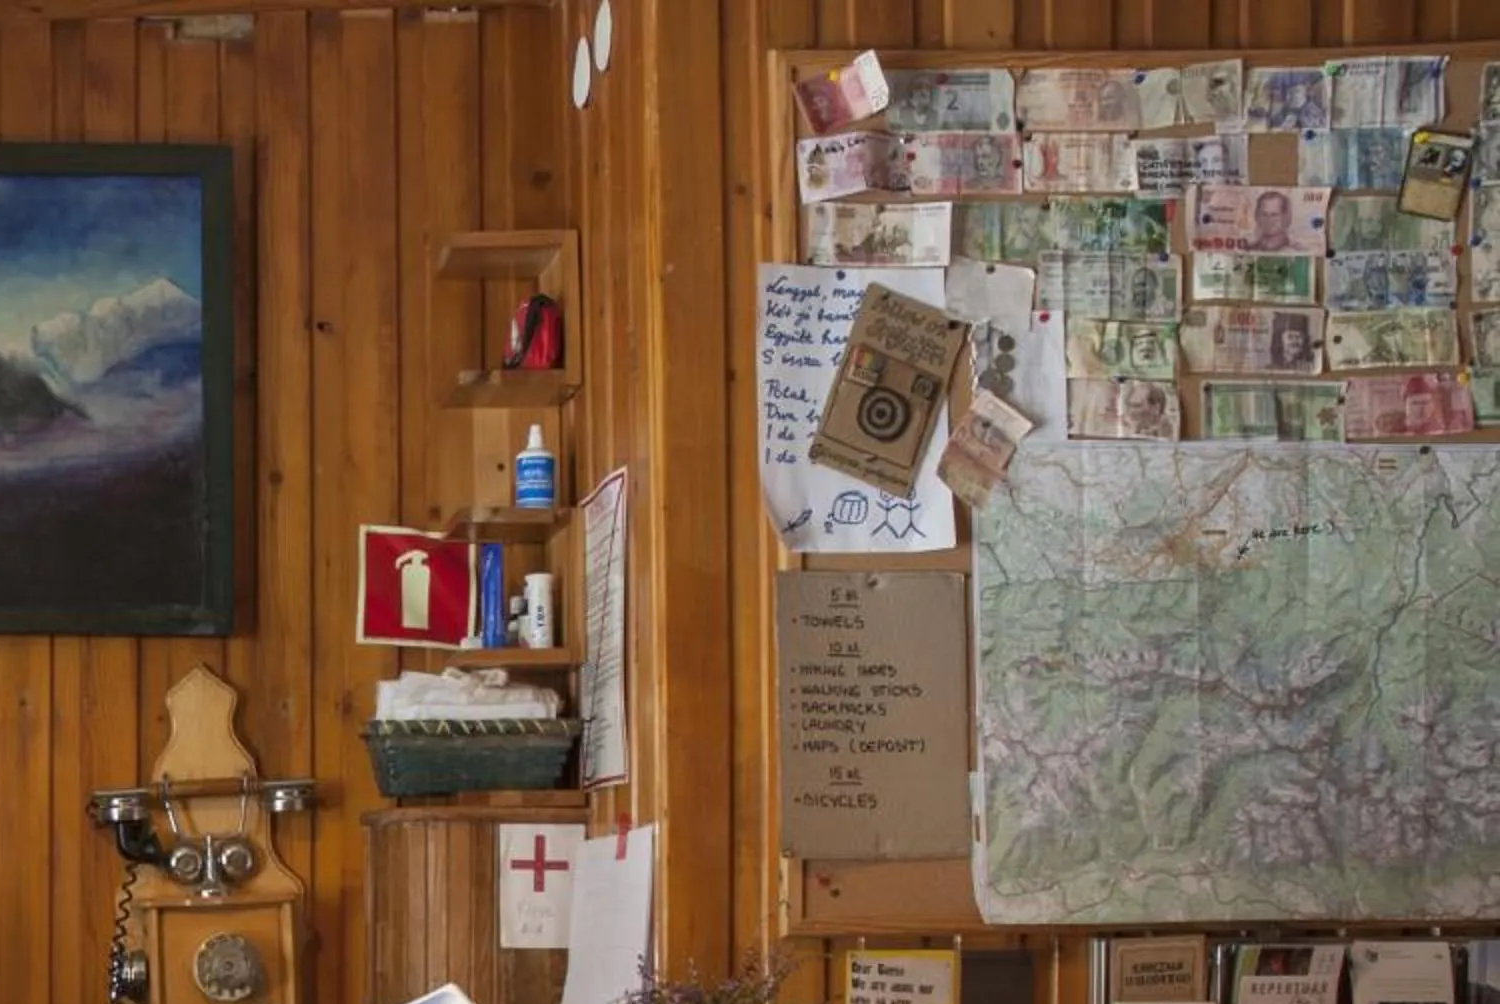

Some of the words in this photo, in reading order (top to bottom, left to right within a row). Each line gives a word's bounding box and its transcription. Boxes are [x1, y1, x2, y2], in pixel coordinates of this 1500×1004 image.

[799, 613, 865, 630] TOWELS
[801, 699, 887, 717] BACKPACKS
[801, 718, 867, 734] LAUNDRY
[802, 792, 877, 809] BICYCLES
